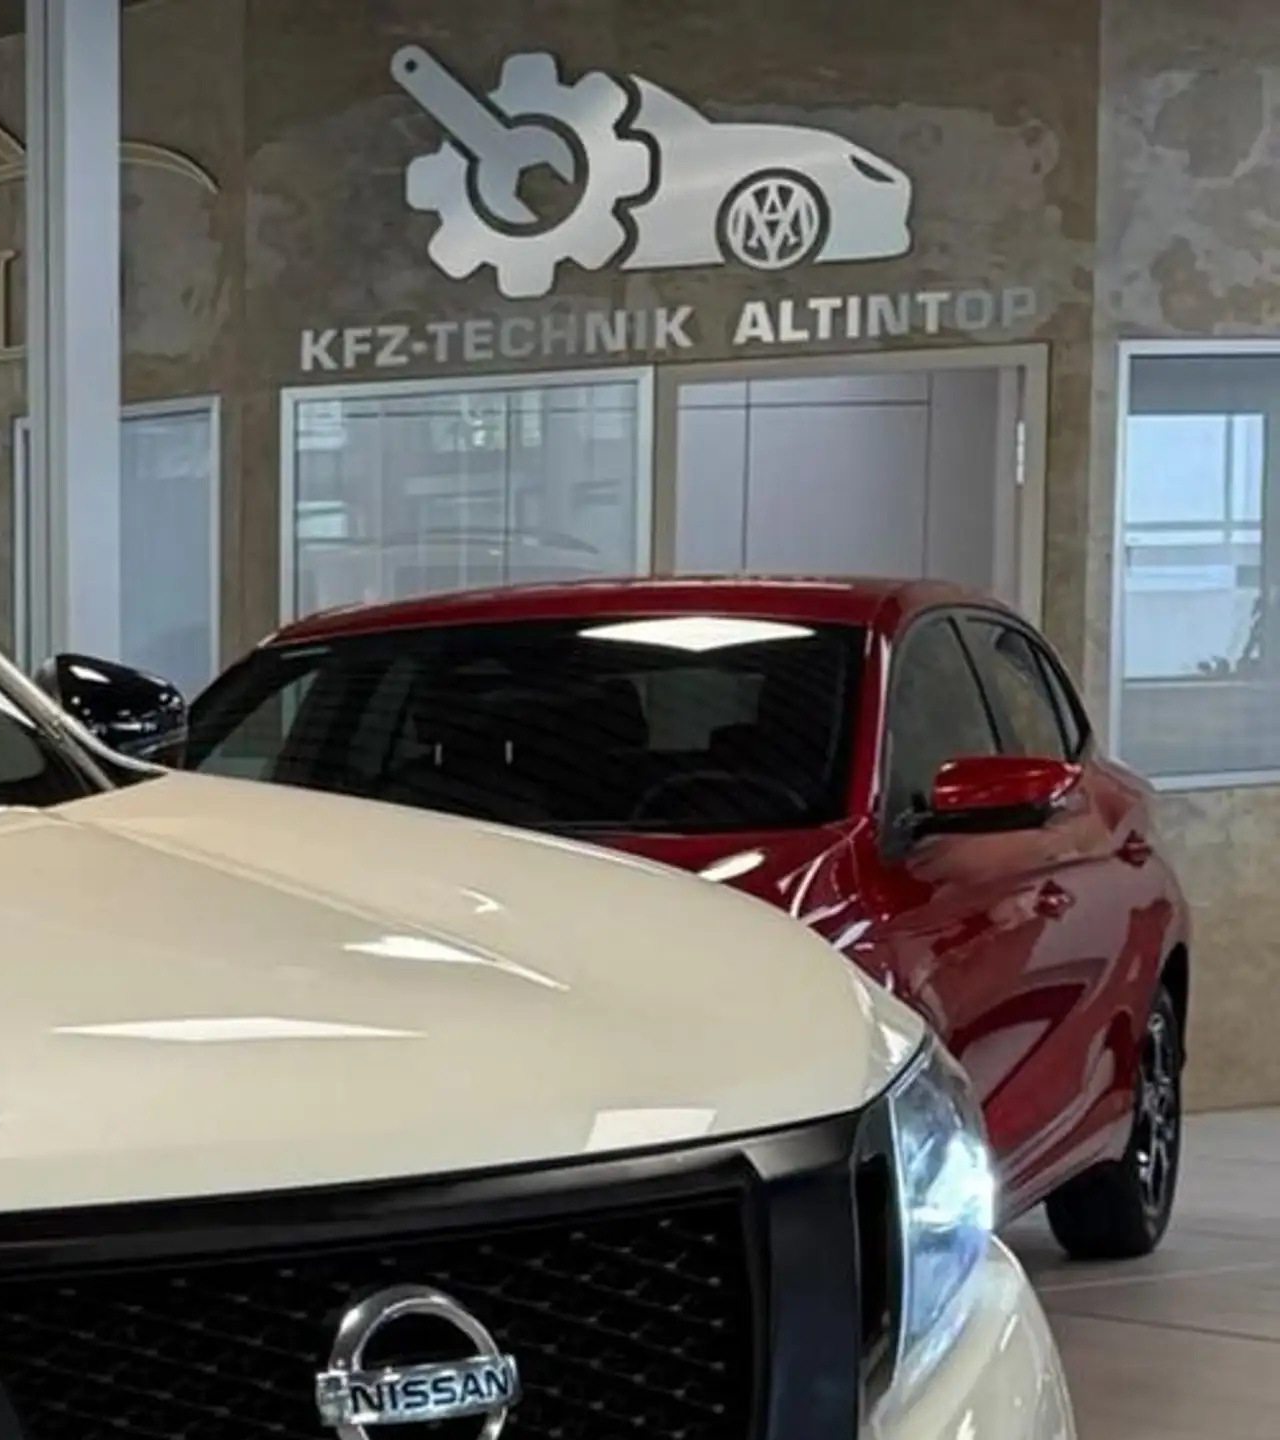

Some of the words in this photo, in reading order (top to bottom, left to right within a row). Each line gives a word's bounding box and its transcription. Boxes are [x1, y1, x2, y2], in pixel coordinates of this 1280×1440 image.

[300, 305, 694, 372] KFZ-TECHNIK
[732, 286, 1038, 345] ALTINTOP
[350, 1366, 510, 1414] NISSAN
